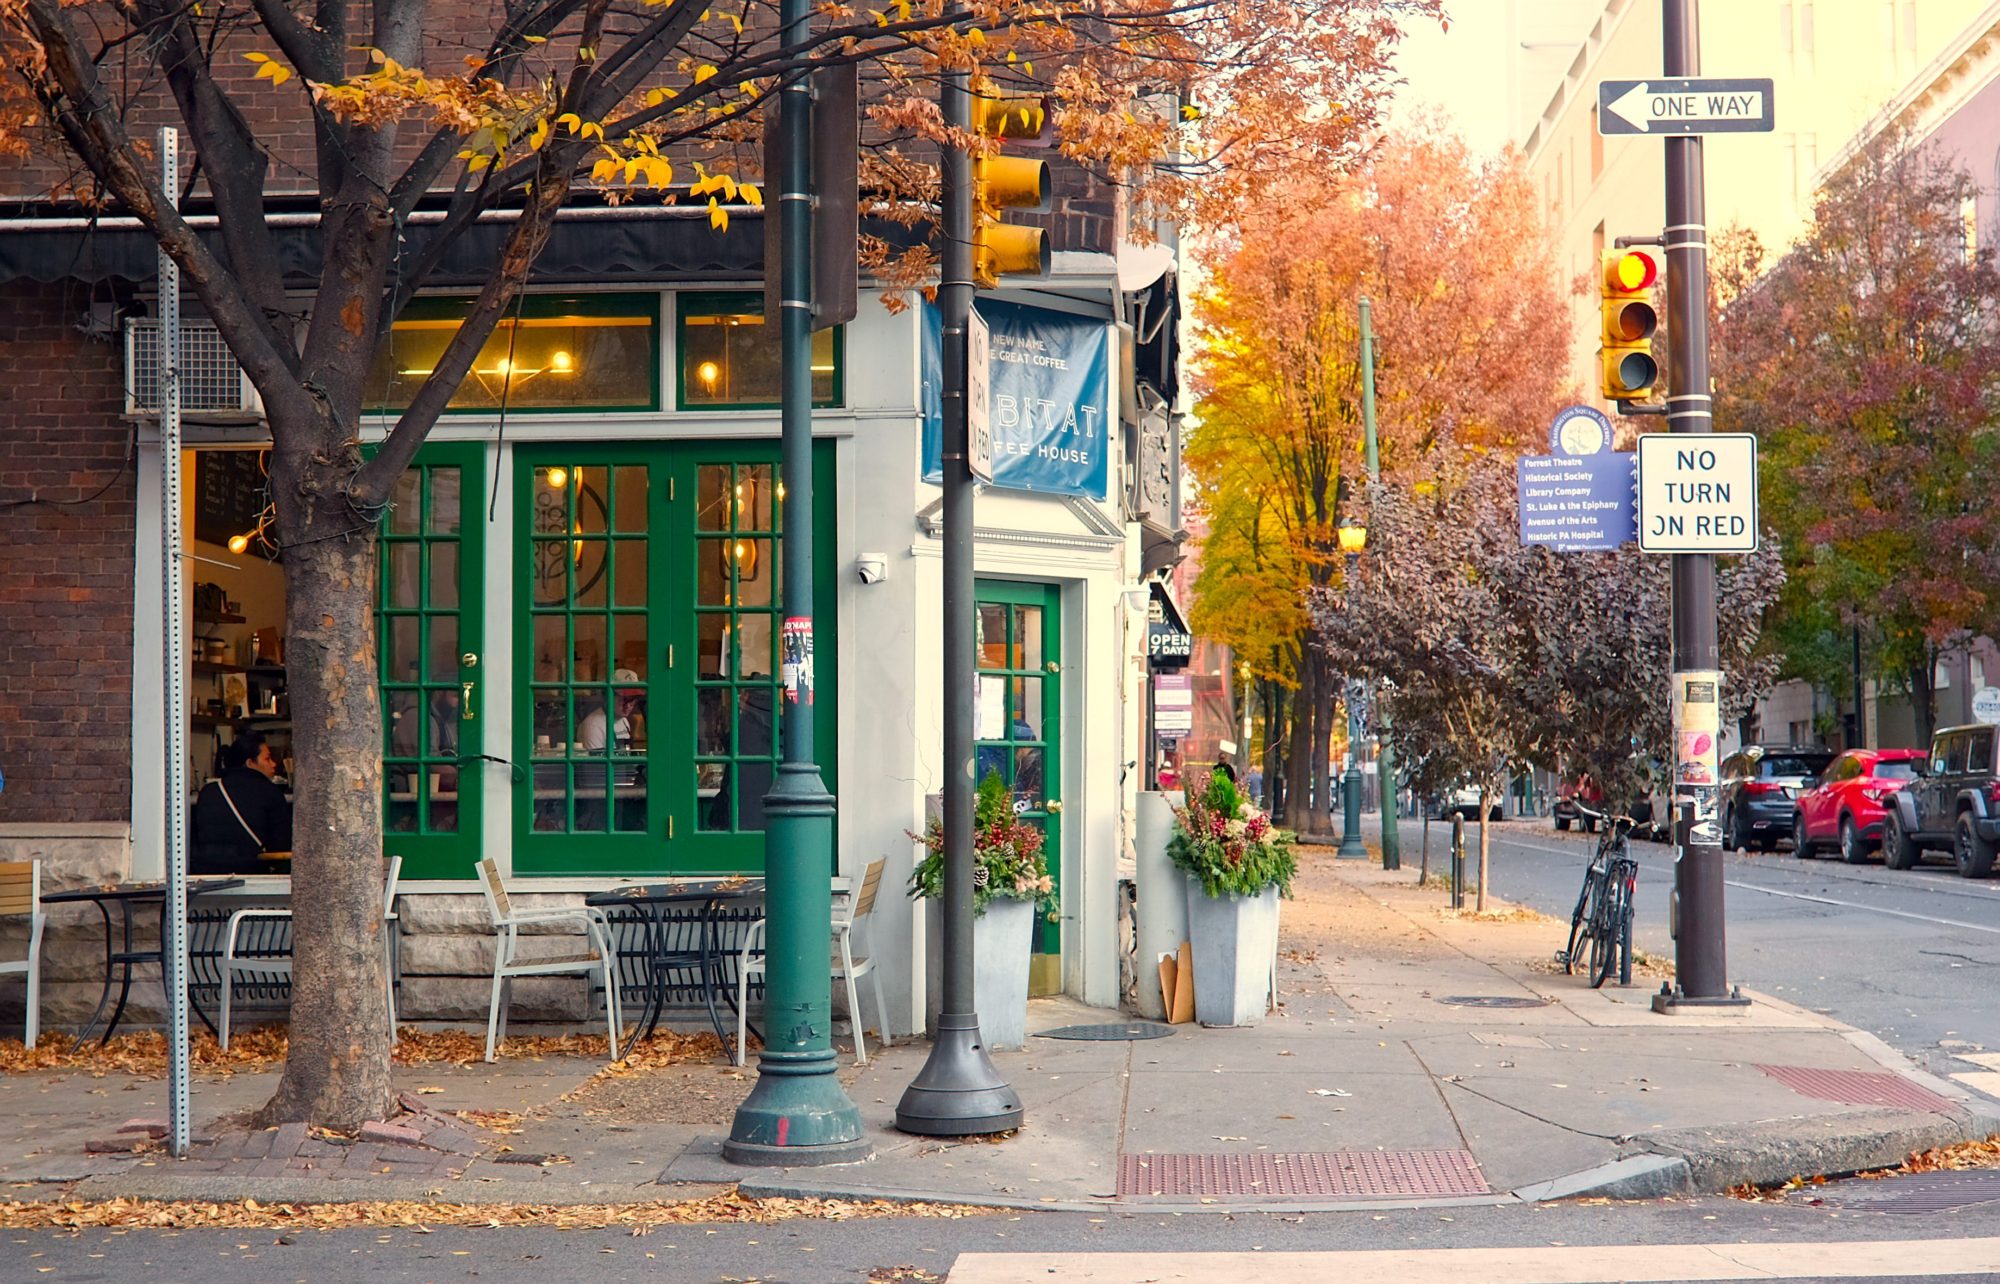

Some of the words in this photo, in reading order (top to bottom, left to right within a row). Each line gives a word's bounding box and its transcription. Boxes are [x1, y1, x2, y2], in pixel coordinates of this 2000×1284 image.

[1652, 96, 1698, 117] ONE
[1707, 95, 1754, 116] WAY
[993, 334, 1015, 347] NEW
[999, 350, 1029, 364] GREAT
[996, 394, 1097, 438] BITAT
[993, 441, 1030, 455] FEE
[1038, 444, 1089, 465] HOUSE
[1525, 458, 1552, 468] Forrest
[1553, 458, 1583, 466] Theatre
[1678, 450, 1716, 470] NO
[1525, 473, 1562, 482] Historical
[1564, 472, 1593, 481] Society
[1525, 488, 1554, 498] Library
[1555, 487, 1591, 496] Company
[1664, 483, 1730, 503] TURN
[1526, 503, 1538, 512] St.
[1539, 502, 1558, 511] Luke
[1559, 502, 1566, 511] &
[1567, 502, 1580, 510] the
[1582, 500, 1619, 510] Epiphany
[1527, 518, 1556, 527] Avenue
[1556, 517, 1566, 526] of
[1566, 517, 1580, 525] the
[1581, 516, 1598, 525] Arts
[1696, 515, 1745, 536] RED
[1527, 531, 1557, 541] Historic
[1559, 531, 1570, 540] PA
[1571, 530, 1604, 541] Hospital
[1150, 634, 1190, 646] OPEN
[1151, 646, 1160, 655] 7
[1162, 645, 1190, 655] DAYS
